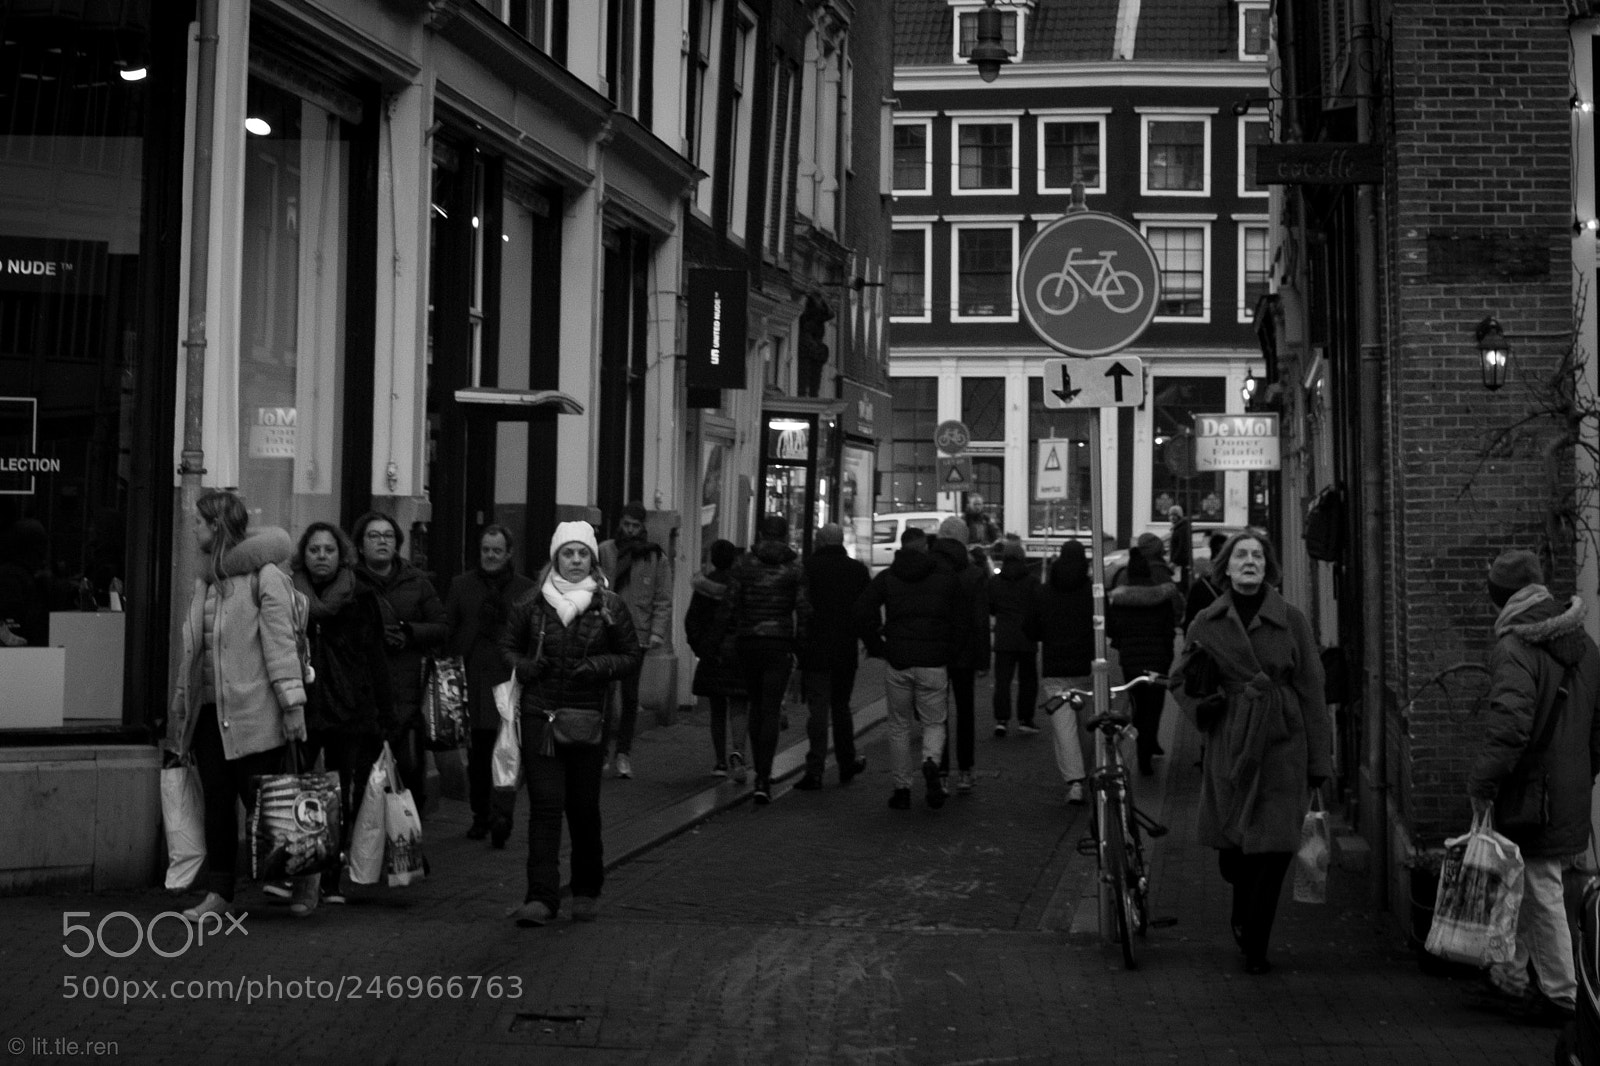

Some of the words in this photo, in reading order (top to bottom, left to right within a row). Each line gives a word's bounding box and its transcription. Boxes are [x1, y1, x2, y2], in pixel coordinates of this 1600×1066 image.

[7, 259, 56, 275] NUDE
[1202, 419, 1229, 436] De
[1233, 418, 1272, 436] Mol
[0, 457, 61, 472] LECTION
